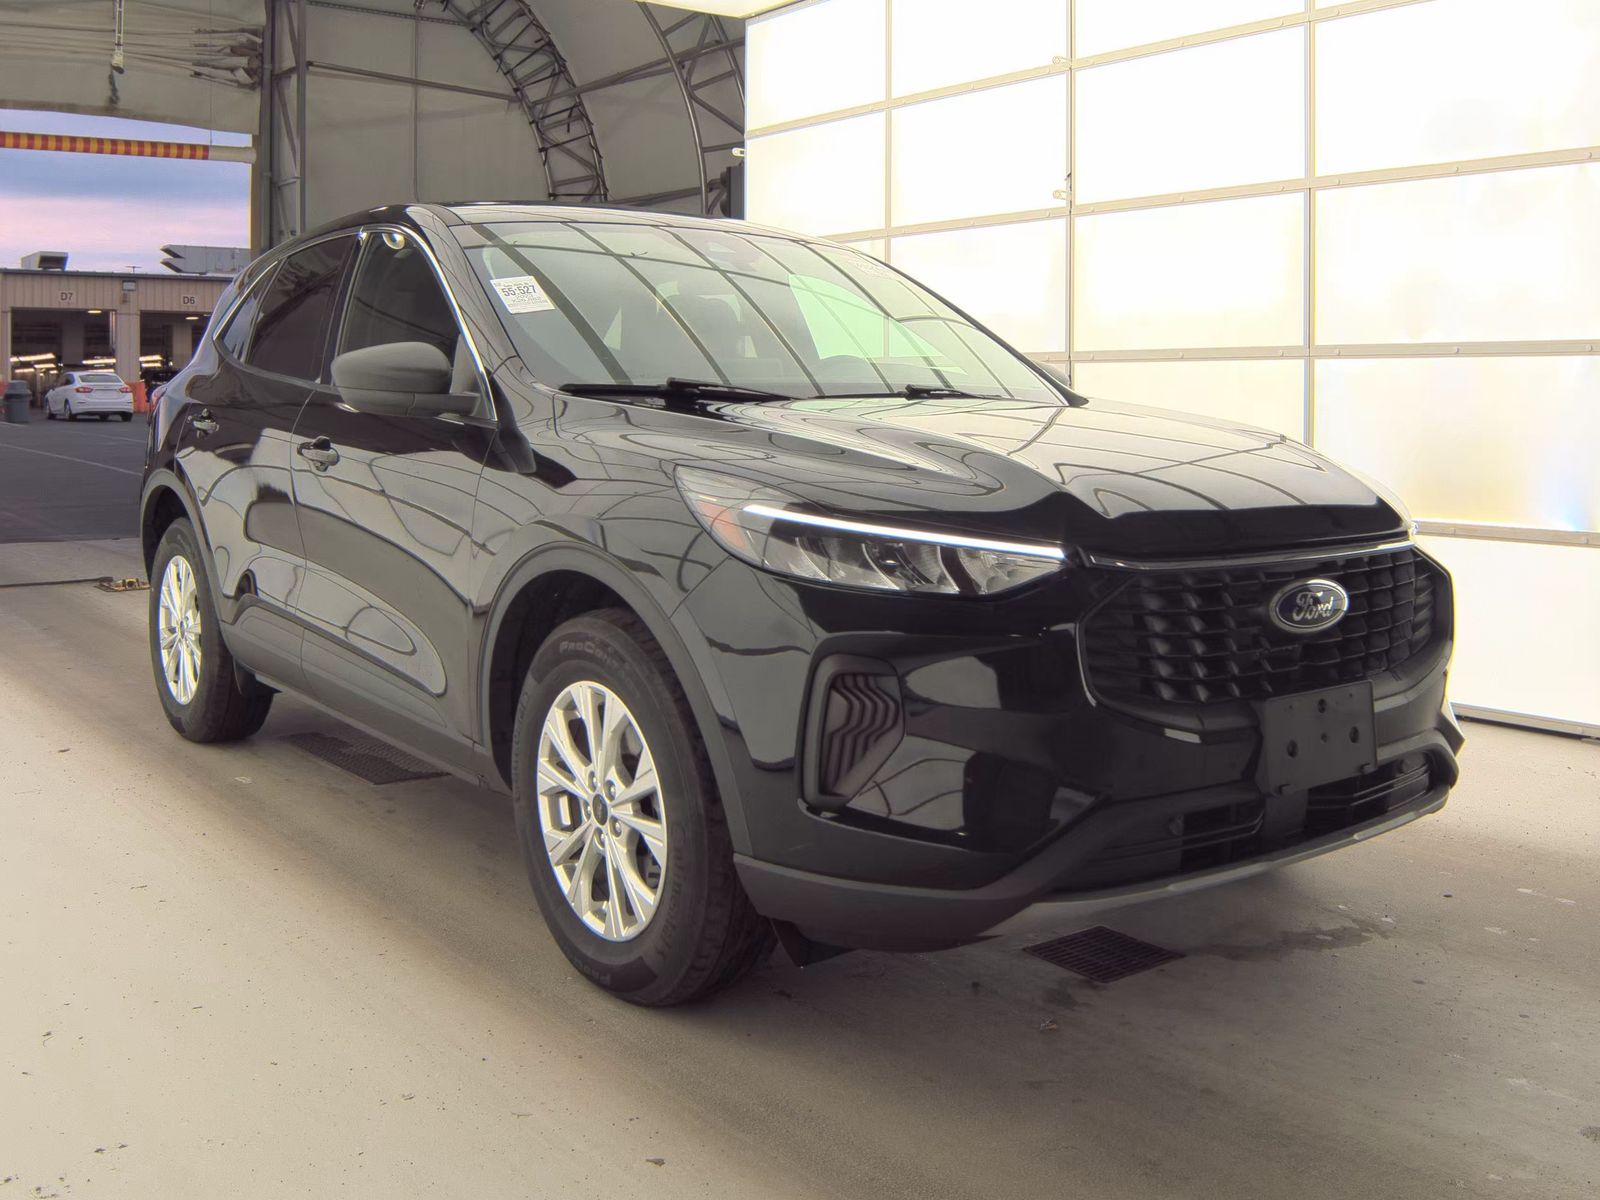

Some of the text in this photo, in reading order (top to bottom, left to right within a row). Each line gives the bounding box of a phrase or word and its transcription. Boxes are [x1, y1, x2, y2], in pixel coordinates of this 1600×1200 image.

[60, 292, 73, 301] D7
[183, 296, 196, 305] D6
[1292, 591, 1335, 621] Ford
